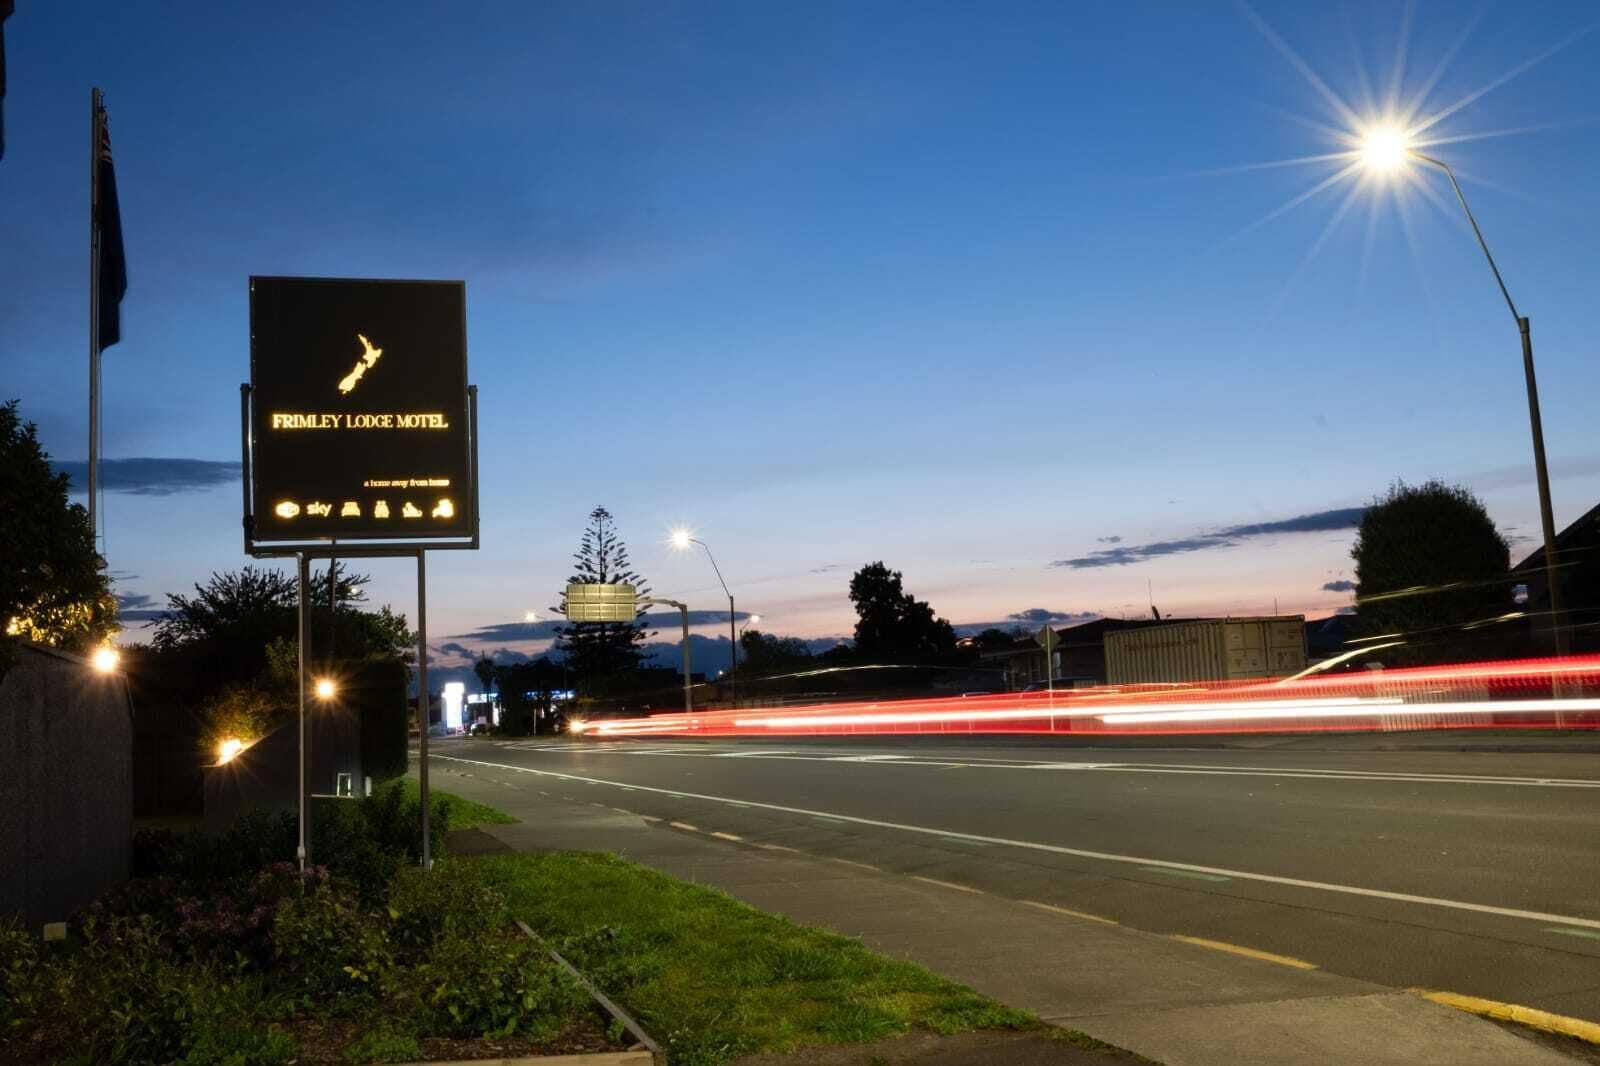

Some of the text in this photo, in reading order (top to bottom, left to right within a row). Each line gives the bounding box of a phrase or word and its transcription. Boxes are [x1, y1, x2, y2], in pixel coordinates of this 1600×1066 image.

[273, 414, 448, 429] FRIMLEY LODGE MOTEL
[306, 500, 332, 517] sky
